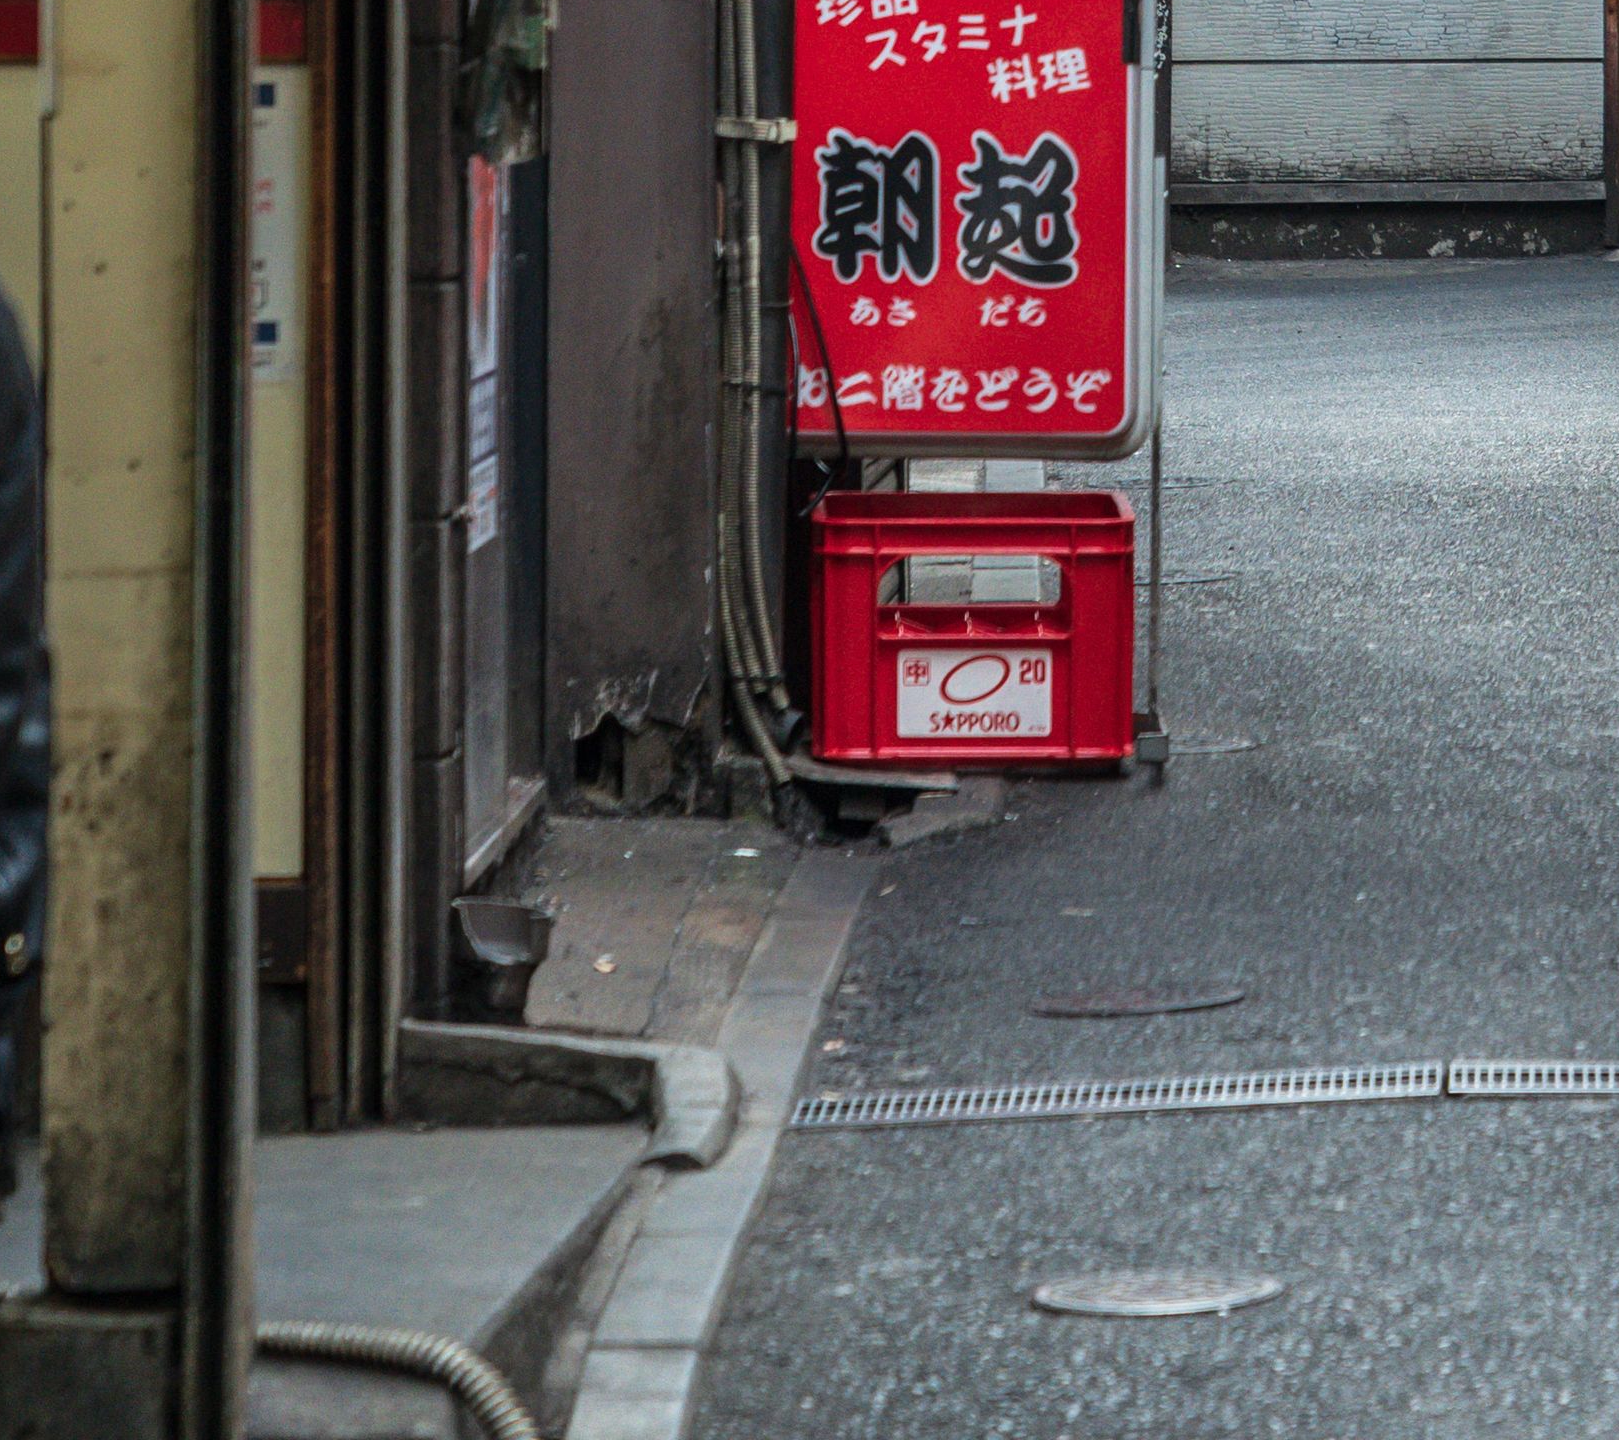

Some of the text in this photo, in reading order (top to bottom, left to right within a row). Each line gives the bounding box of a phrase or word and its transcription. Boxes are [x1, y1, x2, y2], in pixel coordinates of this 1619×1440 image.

[864, 4, 1038, 71] スタミナ
[986, 47, 1091, 104] 料理
[849, 295, 1047, 328] あさ だち
[1019, 659, 1047, 685] 20
